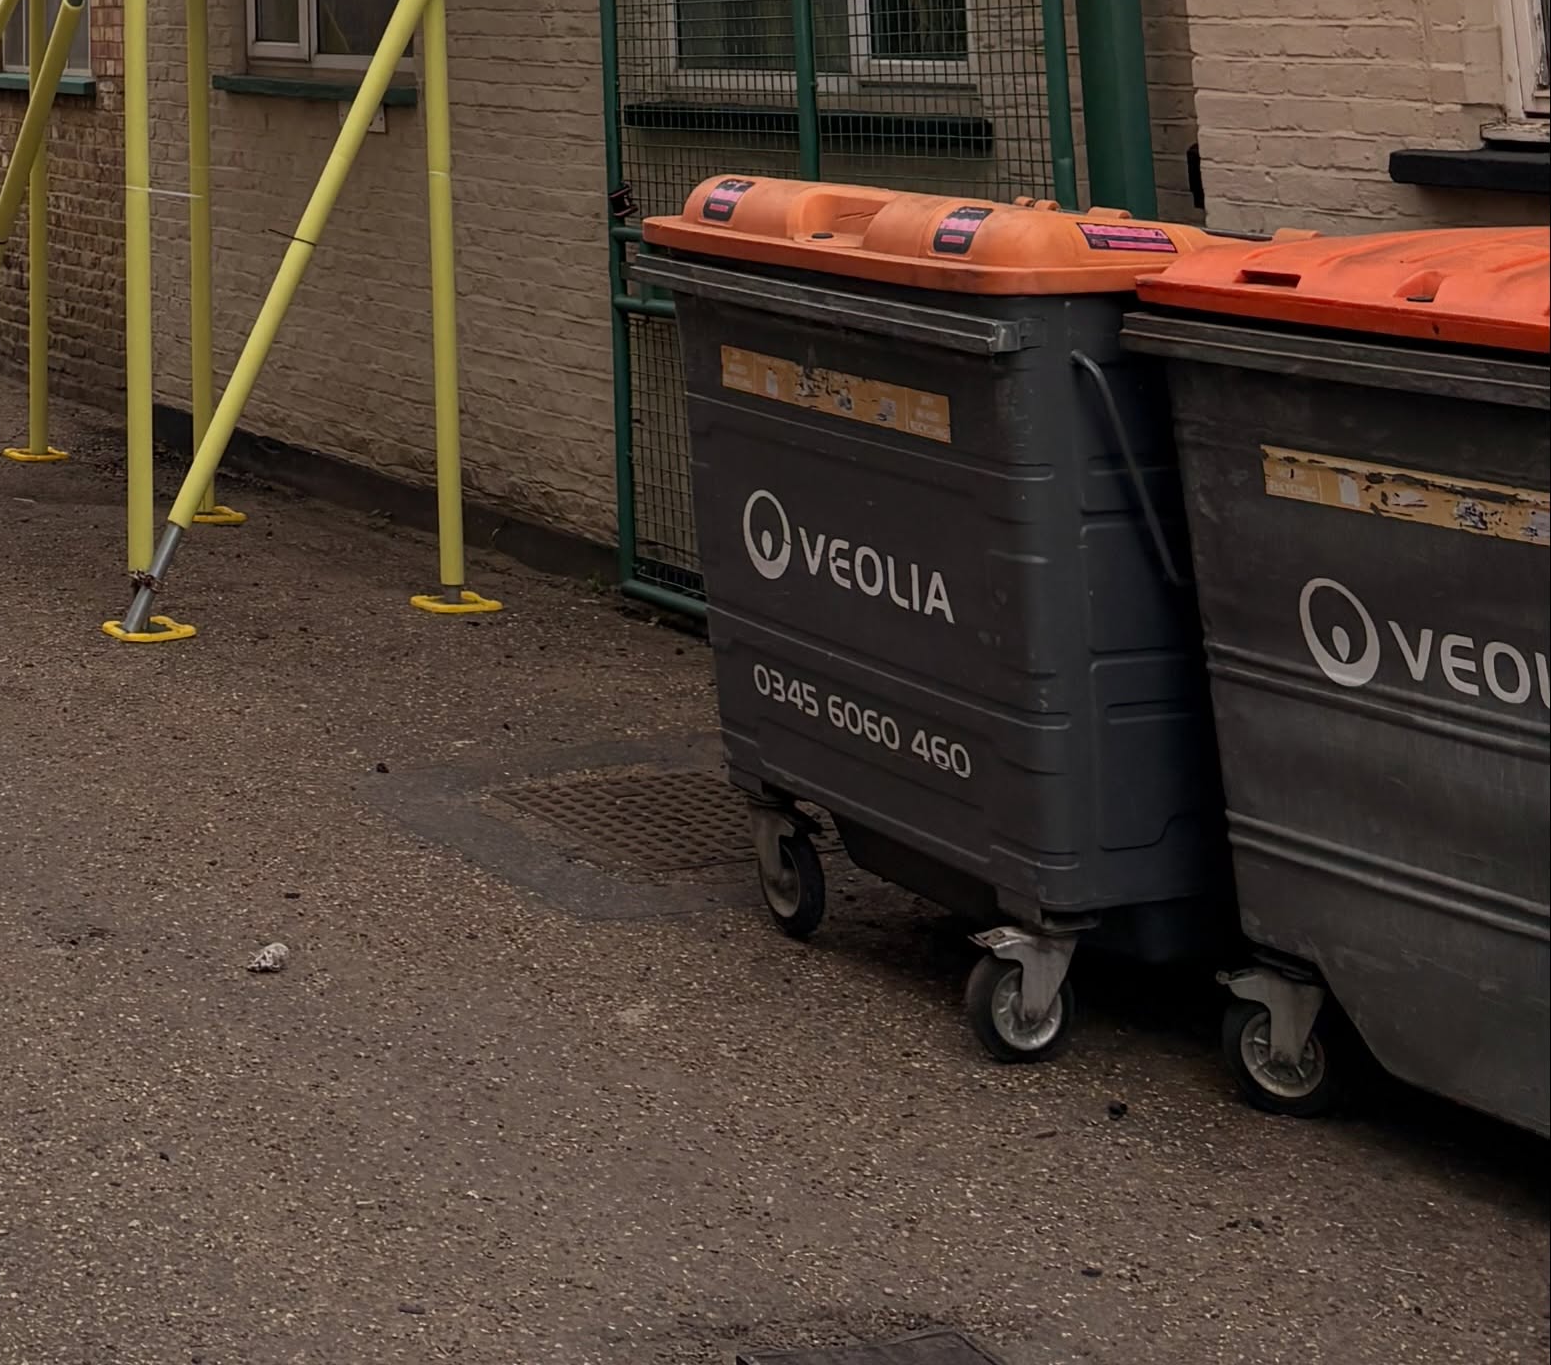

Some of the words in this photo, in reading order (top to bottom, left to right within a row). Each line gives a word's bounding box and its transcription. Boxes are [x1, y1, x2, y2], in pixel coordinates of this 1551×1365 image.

[798, 526, 955, 624] VEOLIA
[753, 664, 819, 717] 0345
[827, 695, 900, 750] 6060
[911, 729, 971, 778] 460
